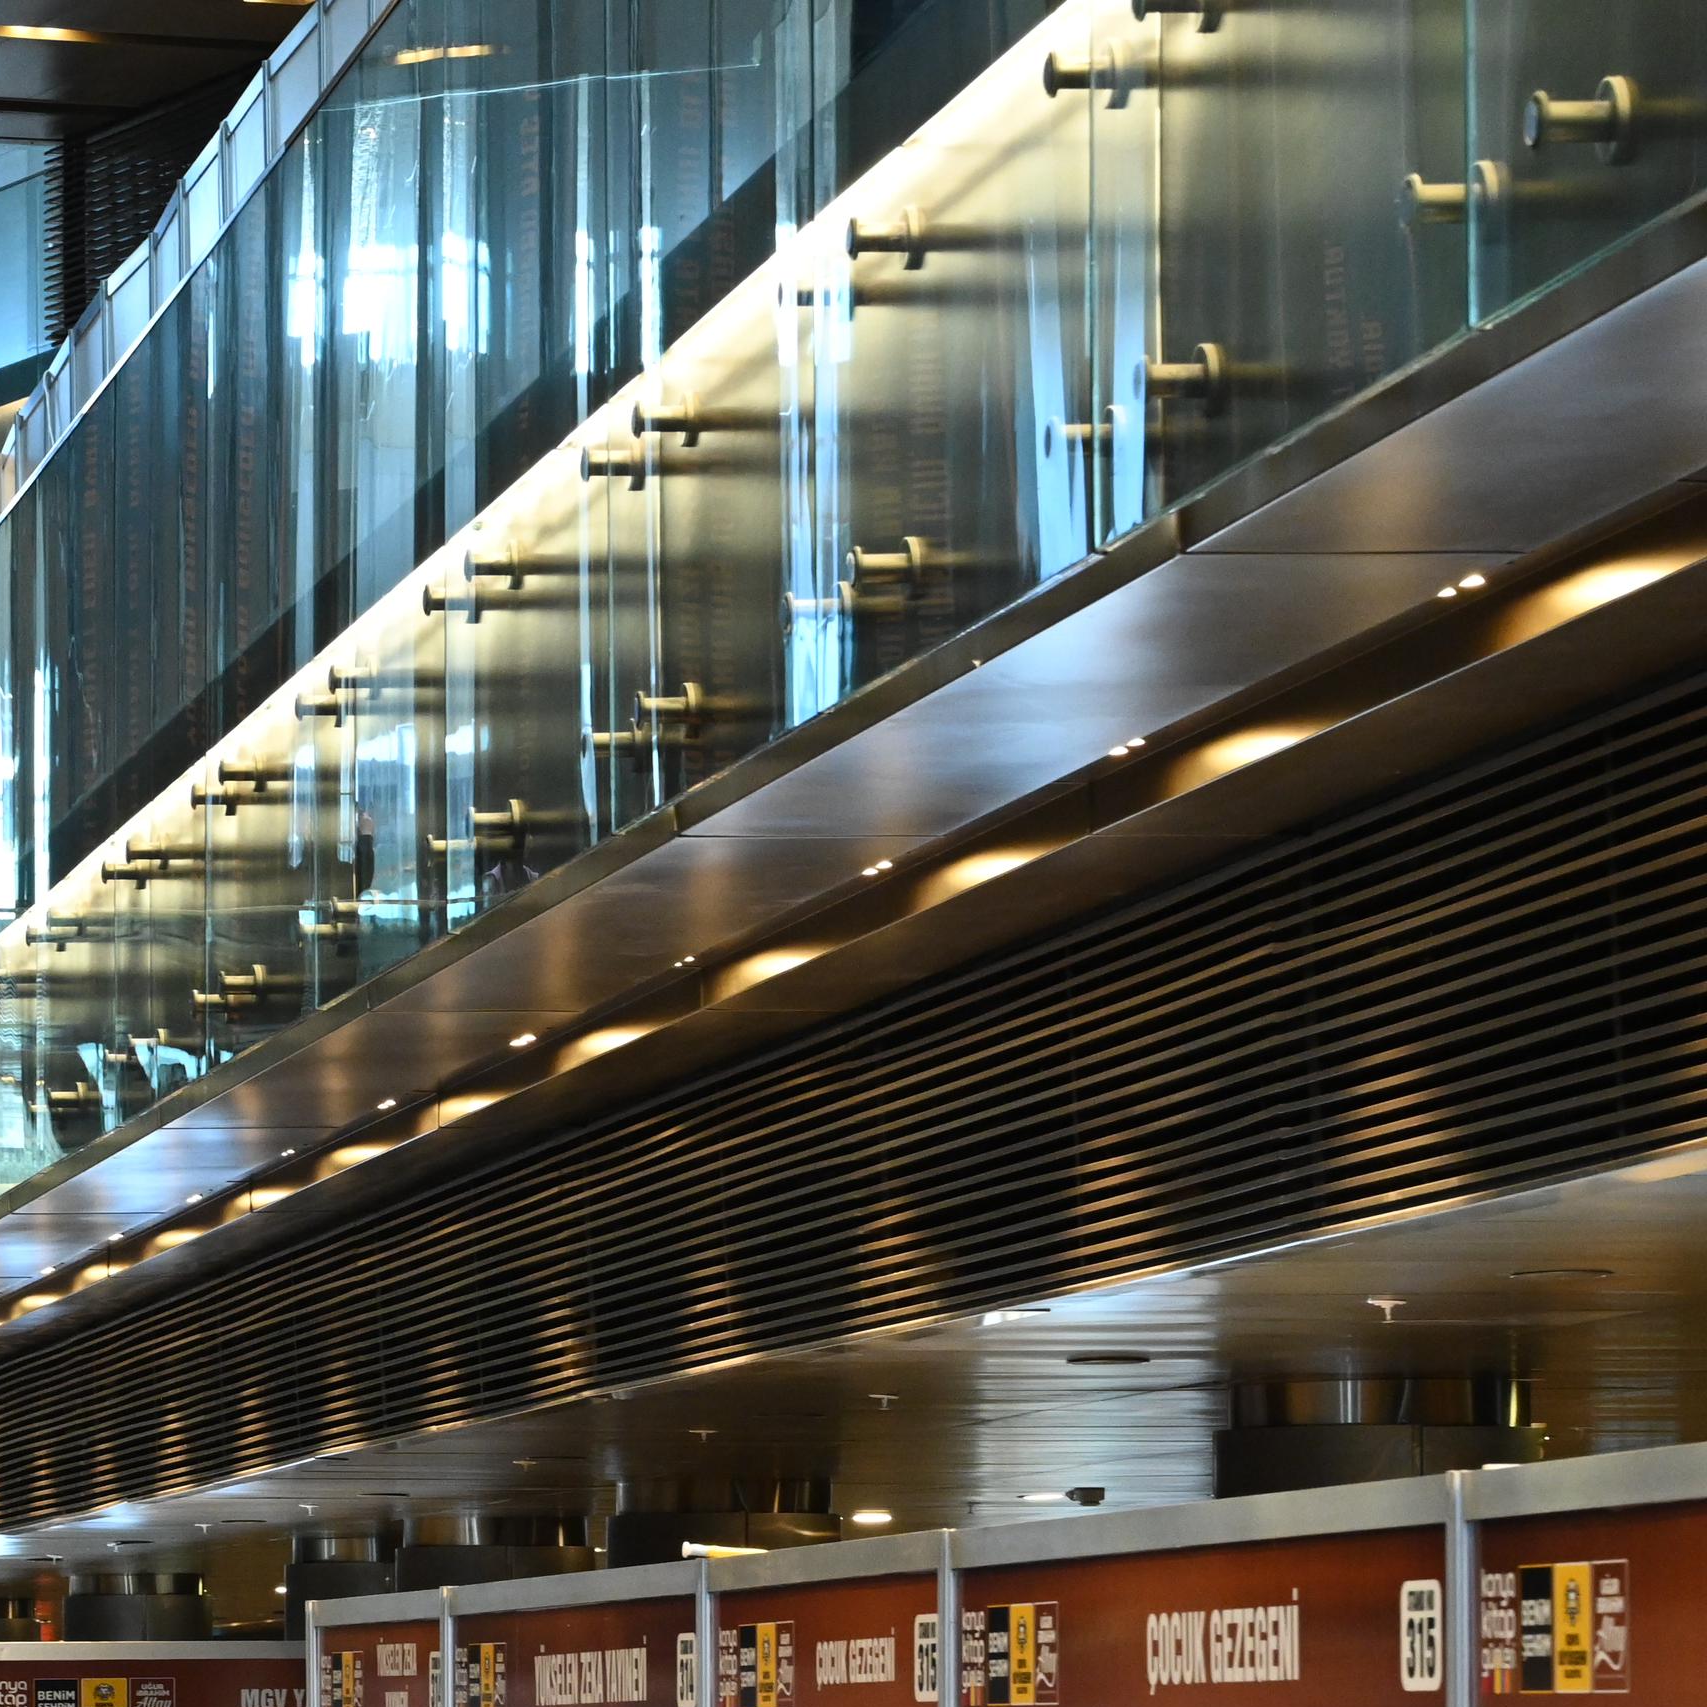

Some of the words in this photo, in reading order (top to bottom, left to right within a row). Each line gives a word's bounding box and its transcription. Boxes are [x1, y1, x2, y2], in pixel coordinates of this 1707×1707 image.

[816, 1638, 848, 1691] ÇOCUK
[917, 1643, 938, 1694] 315
[1146, 1609, 1207, 1696] ÇOCUK
[1209, 1586, 1301, 1685] GEZEGENİ
[1408, 1616, 1437, 1680] 315
